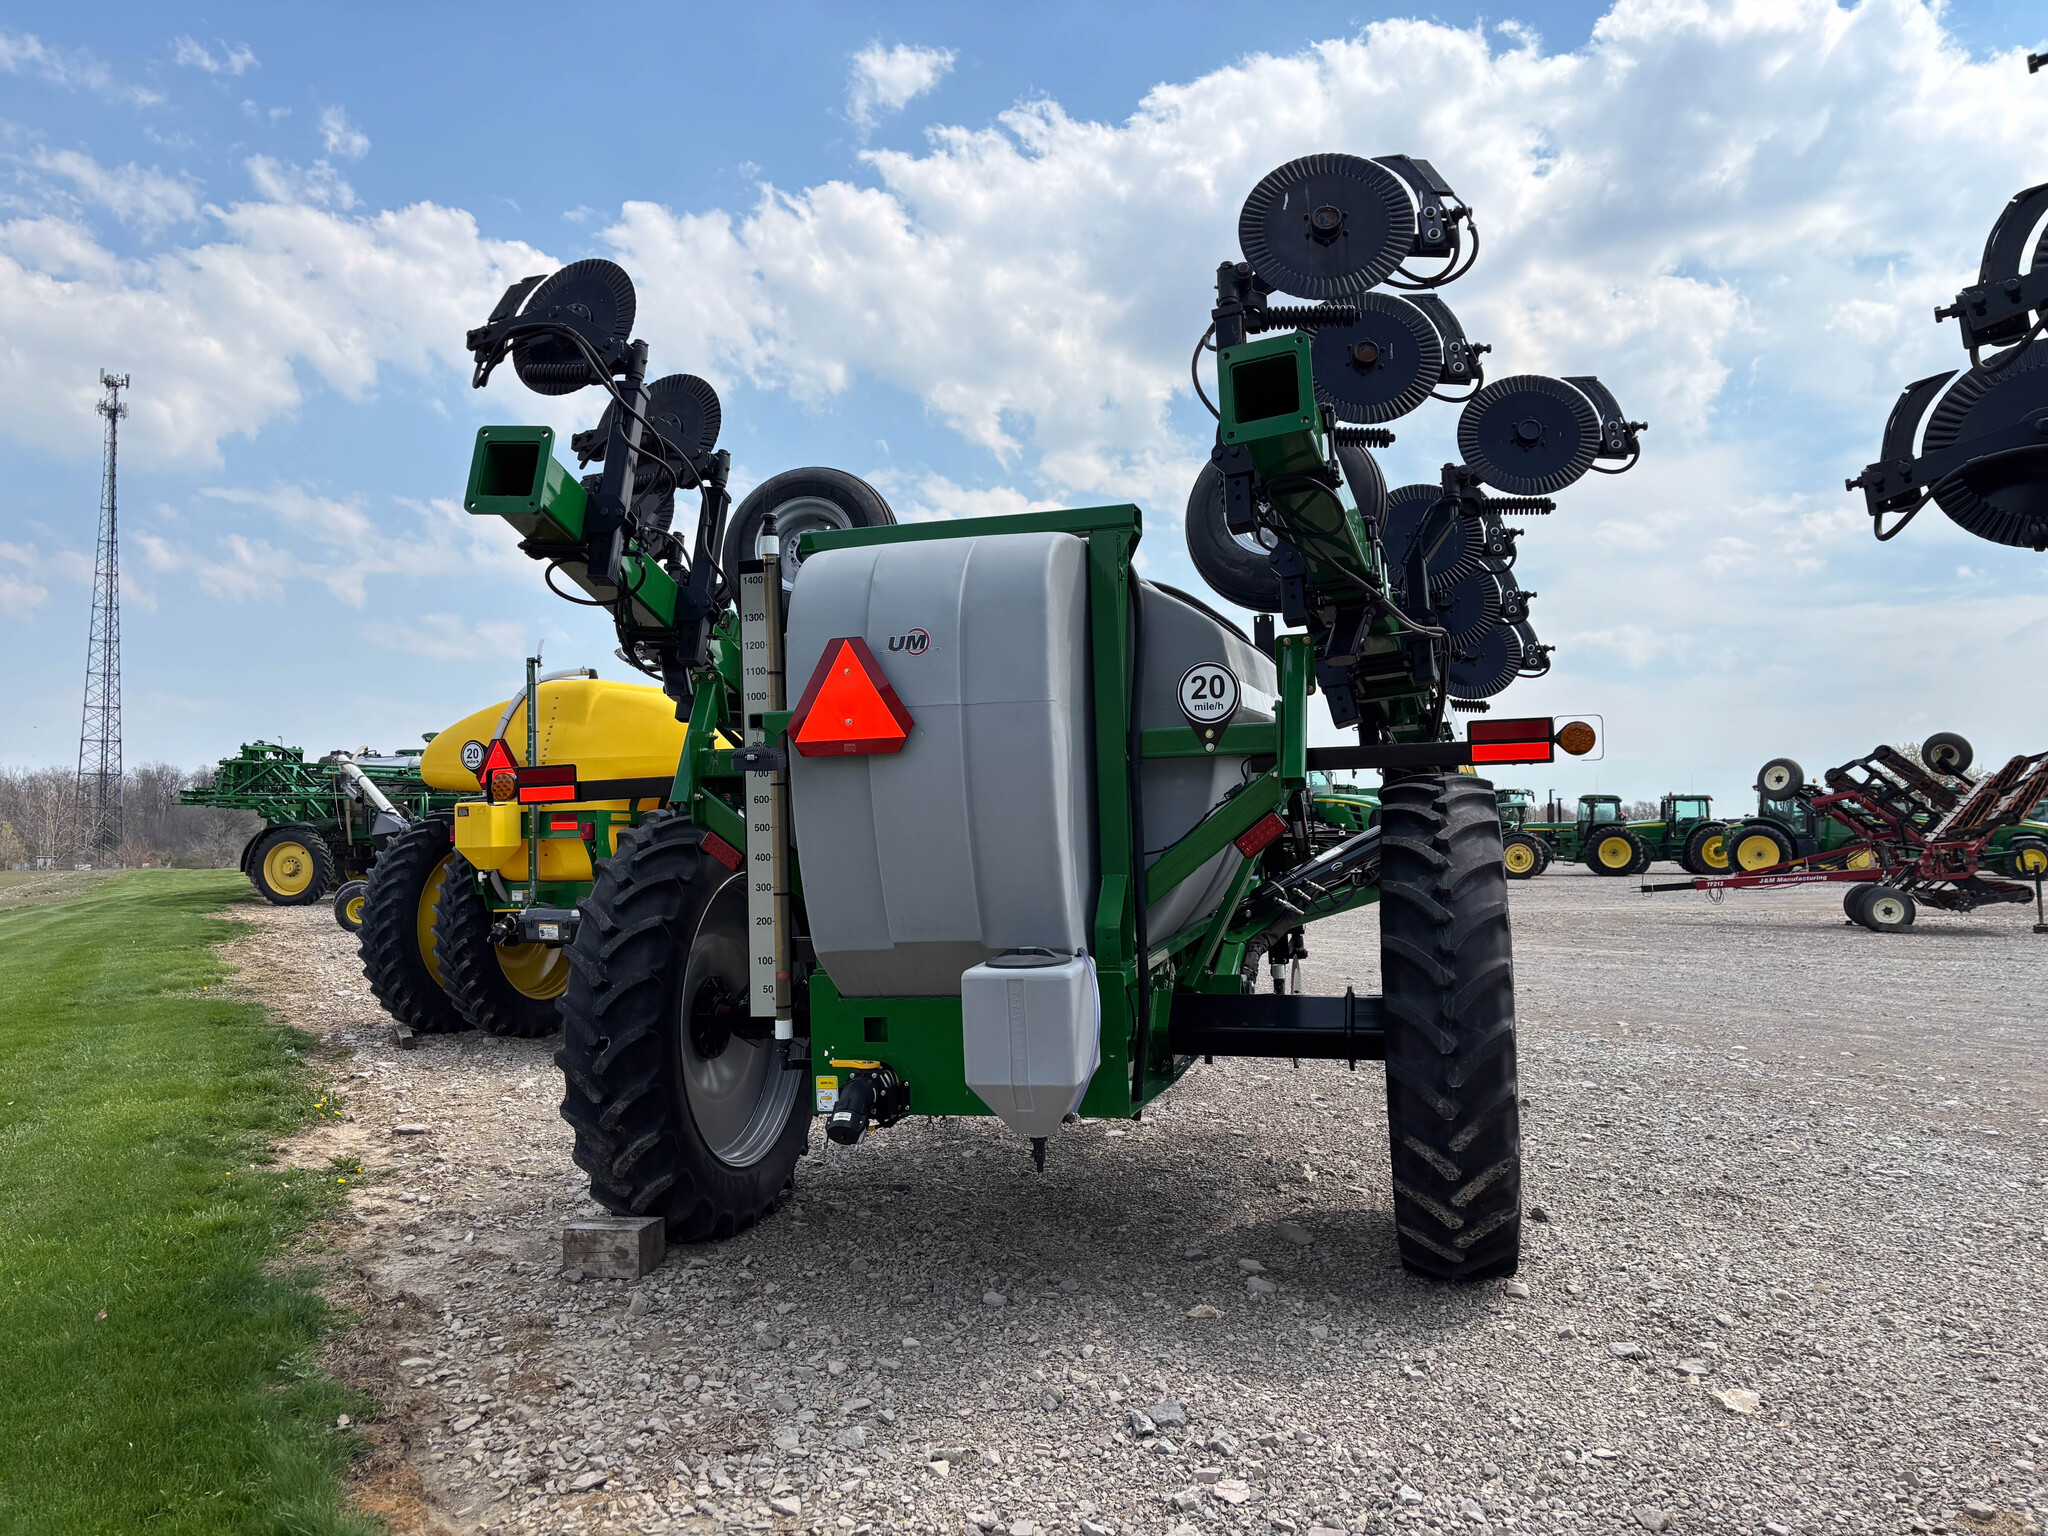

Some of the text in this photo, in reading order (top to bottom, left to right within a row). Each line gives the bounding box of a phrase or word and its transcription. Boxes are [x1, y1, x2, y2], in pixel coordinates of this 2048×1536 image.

[743, 576, 763, 585] 1400
[744, 613, 765, 622] 1300
[745, 641, 765, 650] 1200
[888, 634, 927, 652] UM
[745, 667, 766, 675] 1100
[1190, 674, 1226, 700] 20
[746, 692, 767, 701] 1000
[1194, 701, 1224, 711] mile/h
[466, 748, 479, 759] 20
[753, 770, 769, 778] 700
[753, 795, 770, 804] 600
[754, 823, 770, 832] 500
[755, 853, 771, 862] 400
[1776, 874, 1828, 883] Manufacturing
[755, 883, 772, 892] 300
[756, 917, 772, 926] 200
[757, 956, 773, 965] 100
[762, 985, 774, 993] 50
